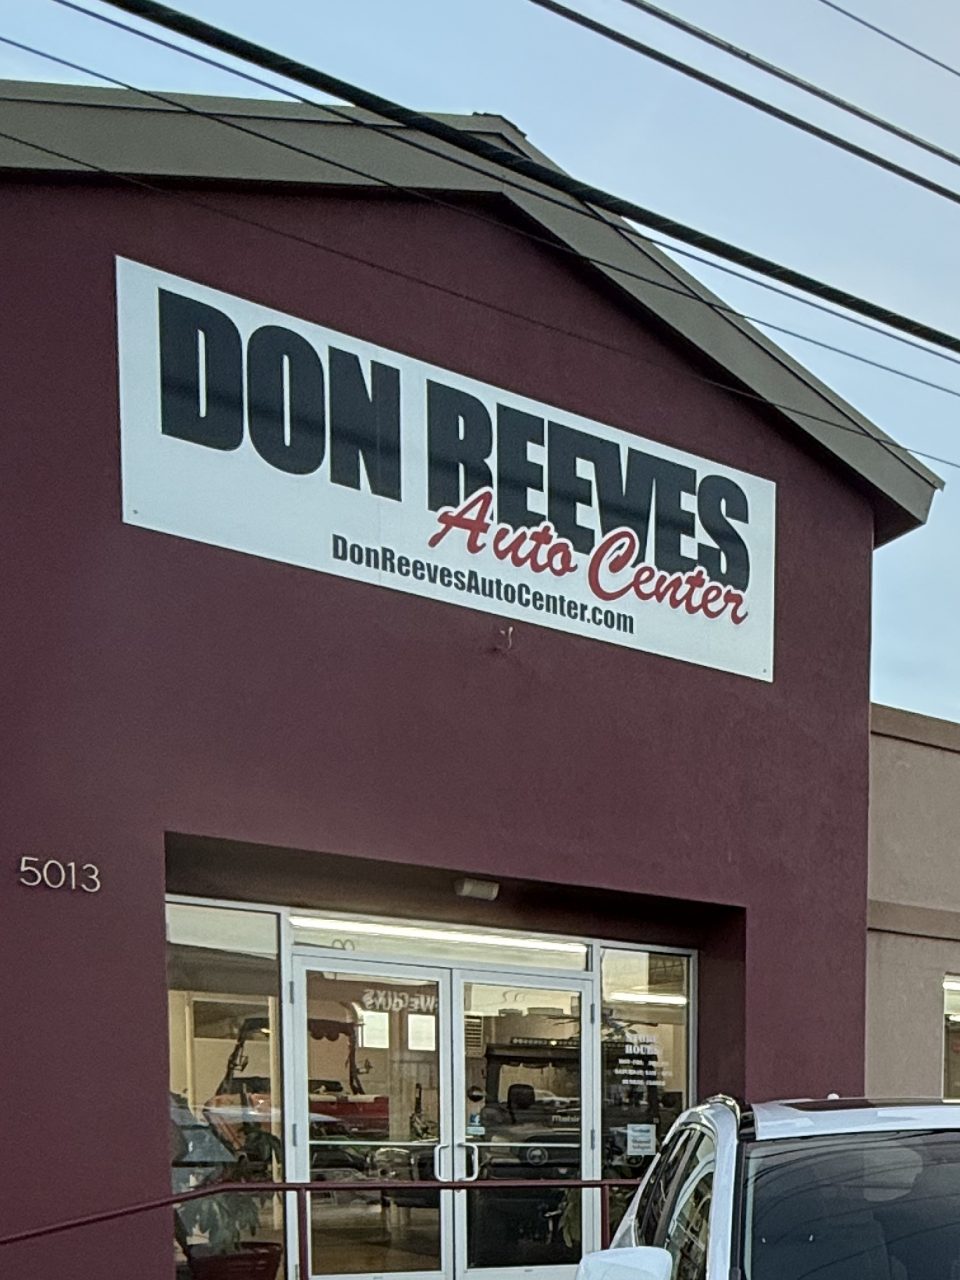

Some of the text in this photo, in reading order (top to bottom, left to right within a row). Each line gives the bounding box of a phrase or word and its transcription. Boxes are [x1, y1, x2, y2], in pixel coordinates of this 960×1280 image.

[158, 286, 750, 591] DON REEVES
[332, 533, 635, 634] DonReevesAutoCenter.com
[428, 490, 749, 625] Auto Center
[20, 856, 101, 893] 5013
